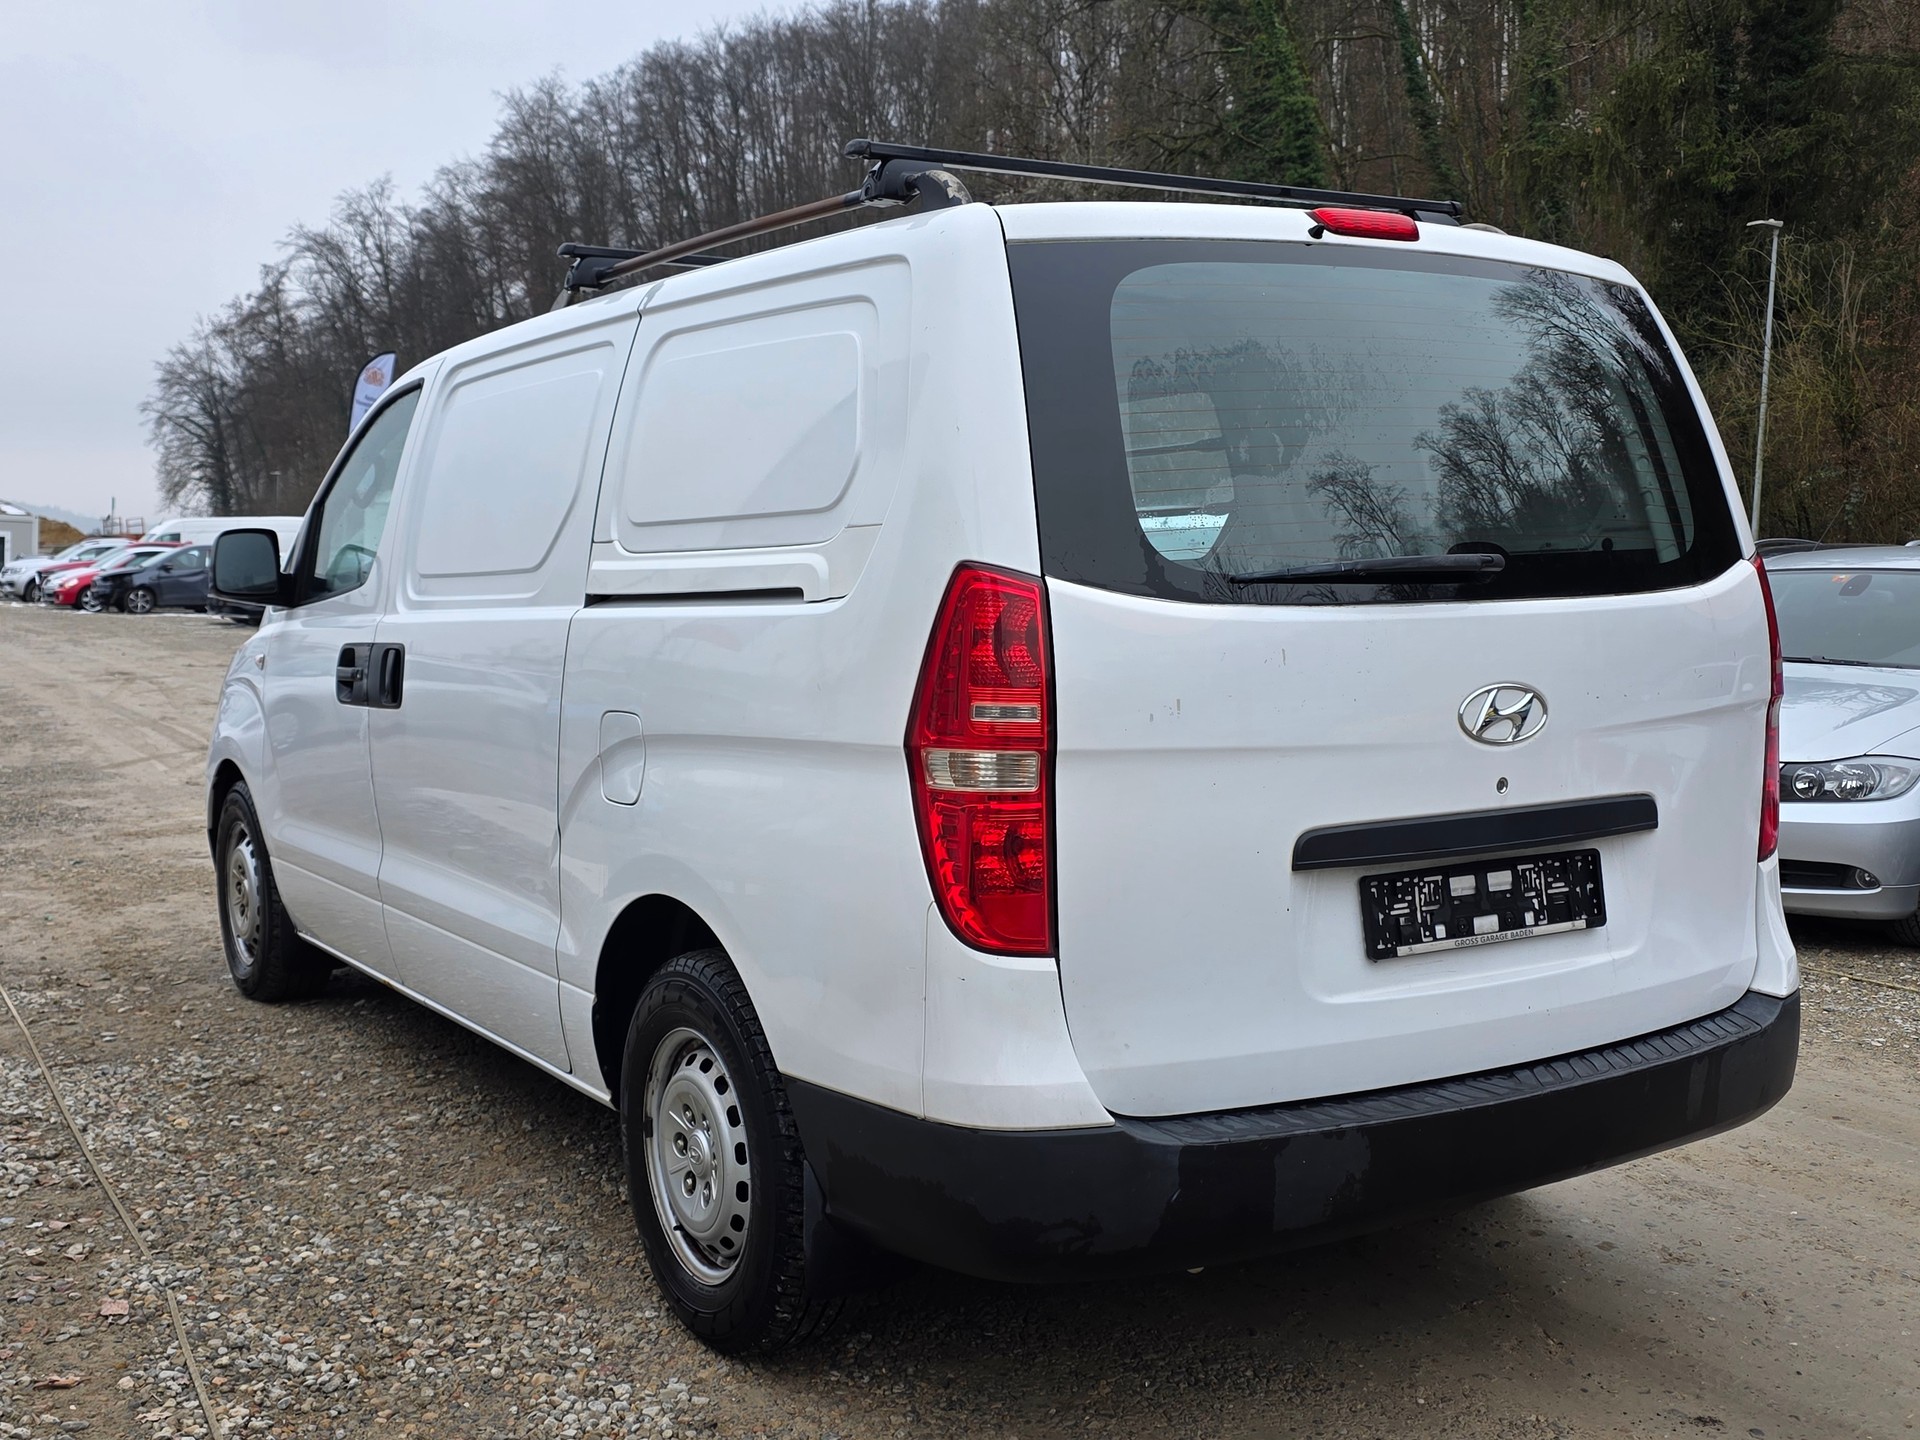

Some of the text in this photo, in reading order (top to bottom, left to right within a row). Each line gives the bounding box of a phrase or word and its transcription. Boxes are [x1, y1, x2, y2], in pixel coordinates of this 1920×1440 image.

[1454, 929, 1534, 947] GROSS GARAGE BADEN
